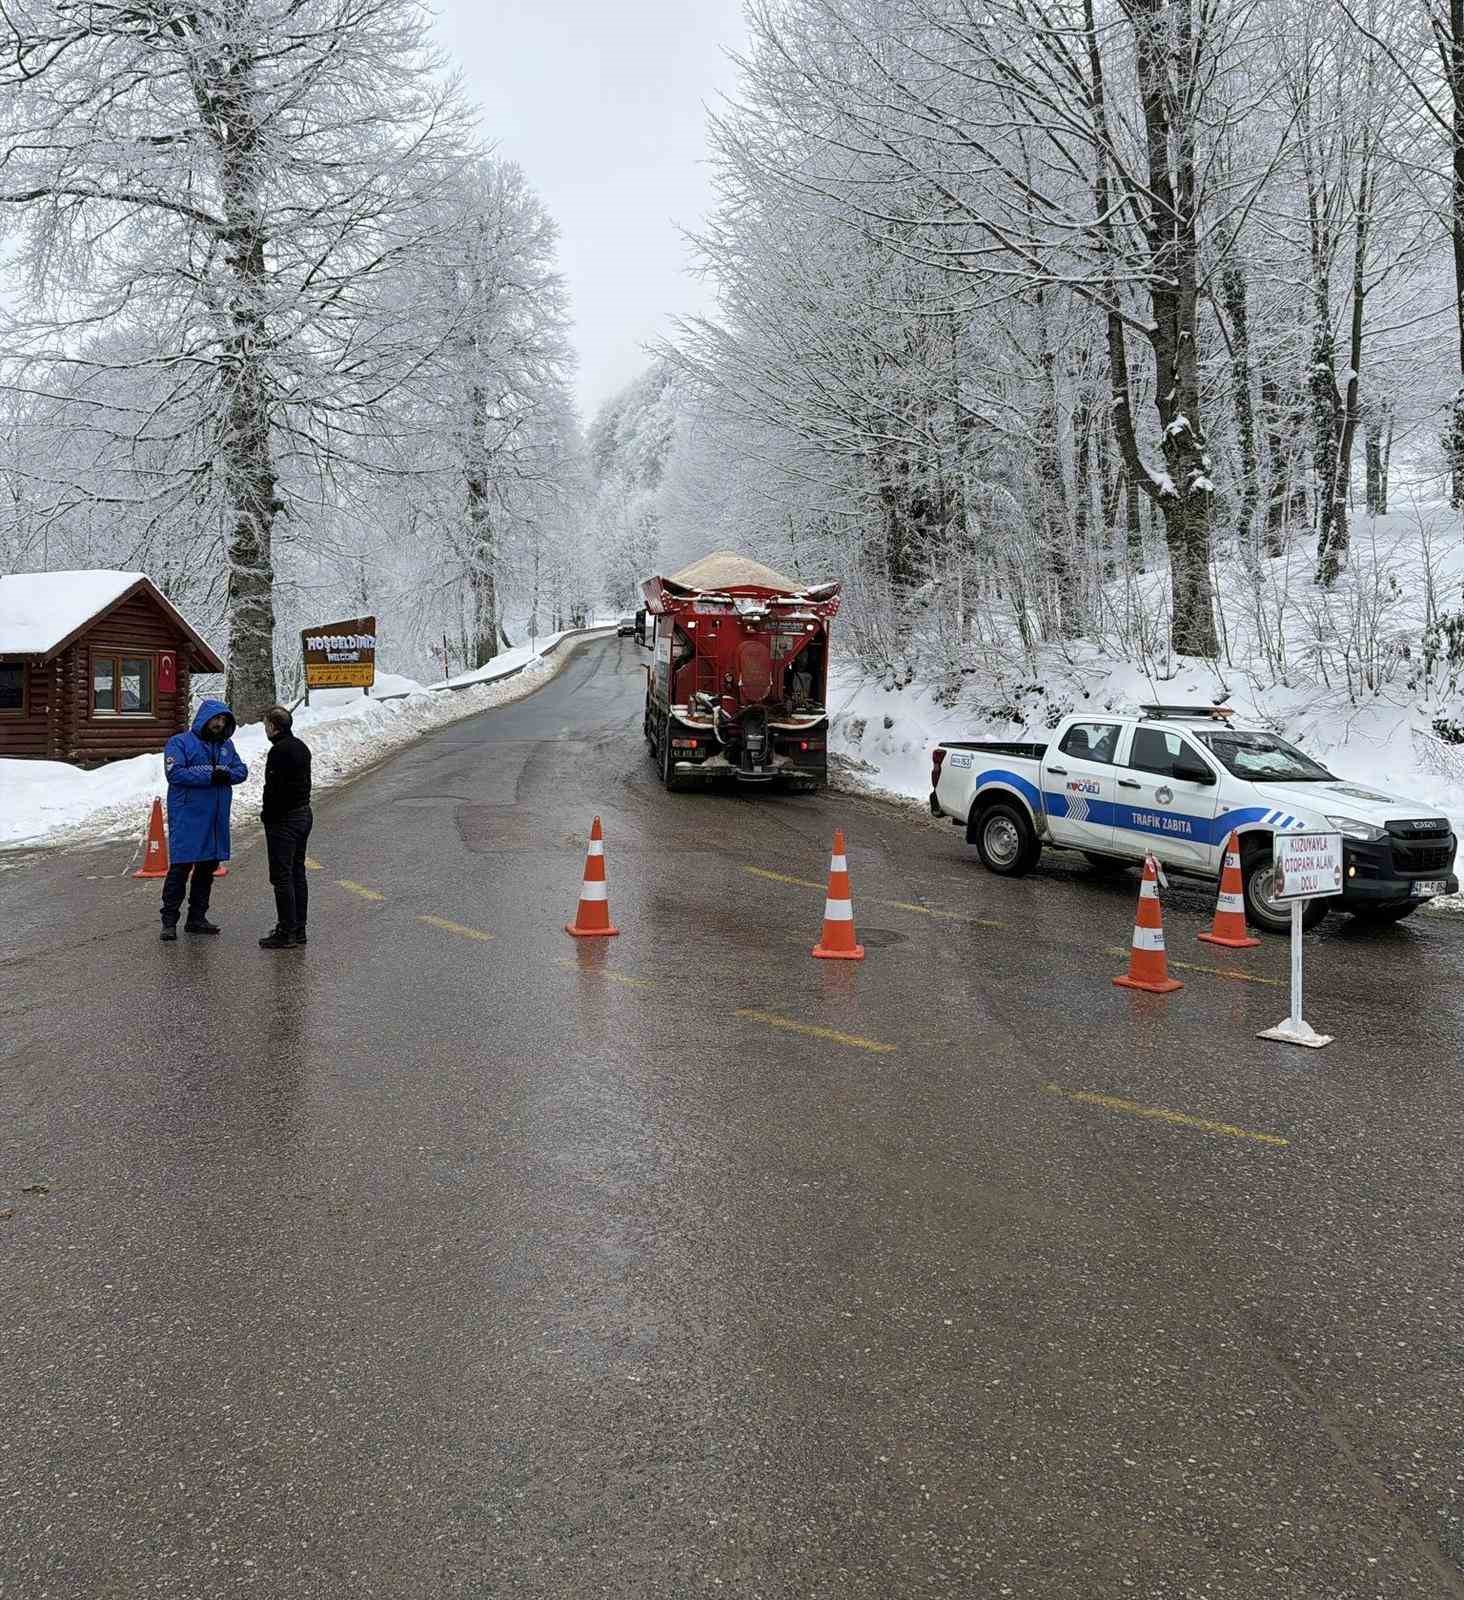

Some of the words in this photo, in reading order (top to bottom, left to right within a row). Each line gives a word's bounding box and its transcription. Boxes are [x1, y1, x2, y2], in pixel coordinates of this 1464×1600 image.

[1162, 817, 1192, 833] ZABITA
[1289, 836, 1328, 853] KUZUYAYLA
[1285, 857, 1315, 873] OTOPARK
[1300, 874, 1319, 891] DOLU
